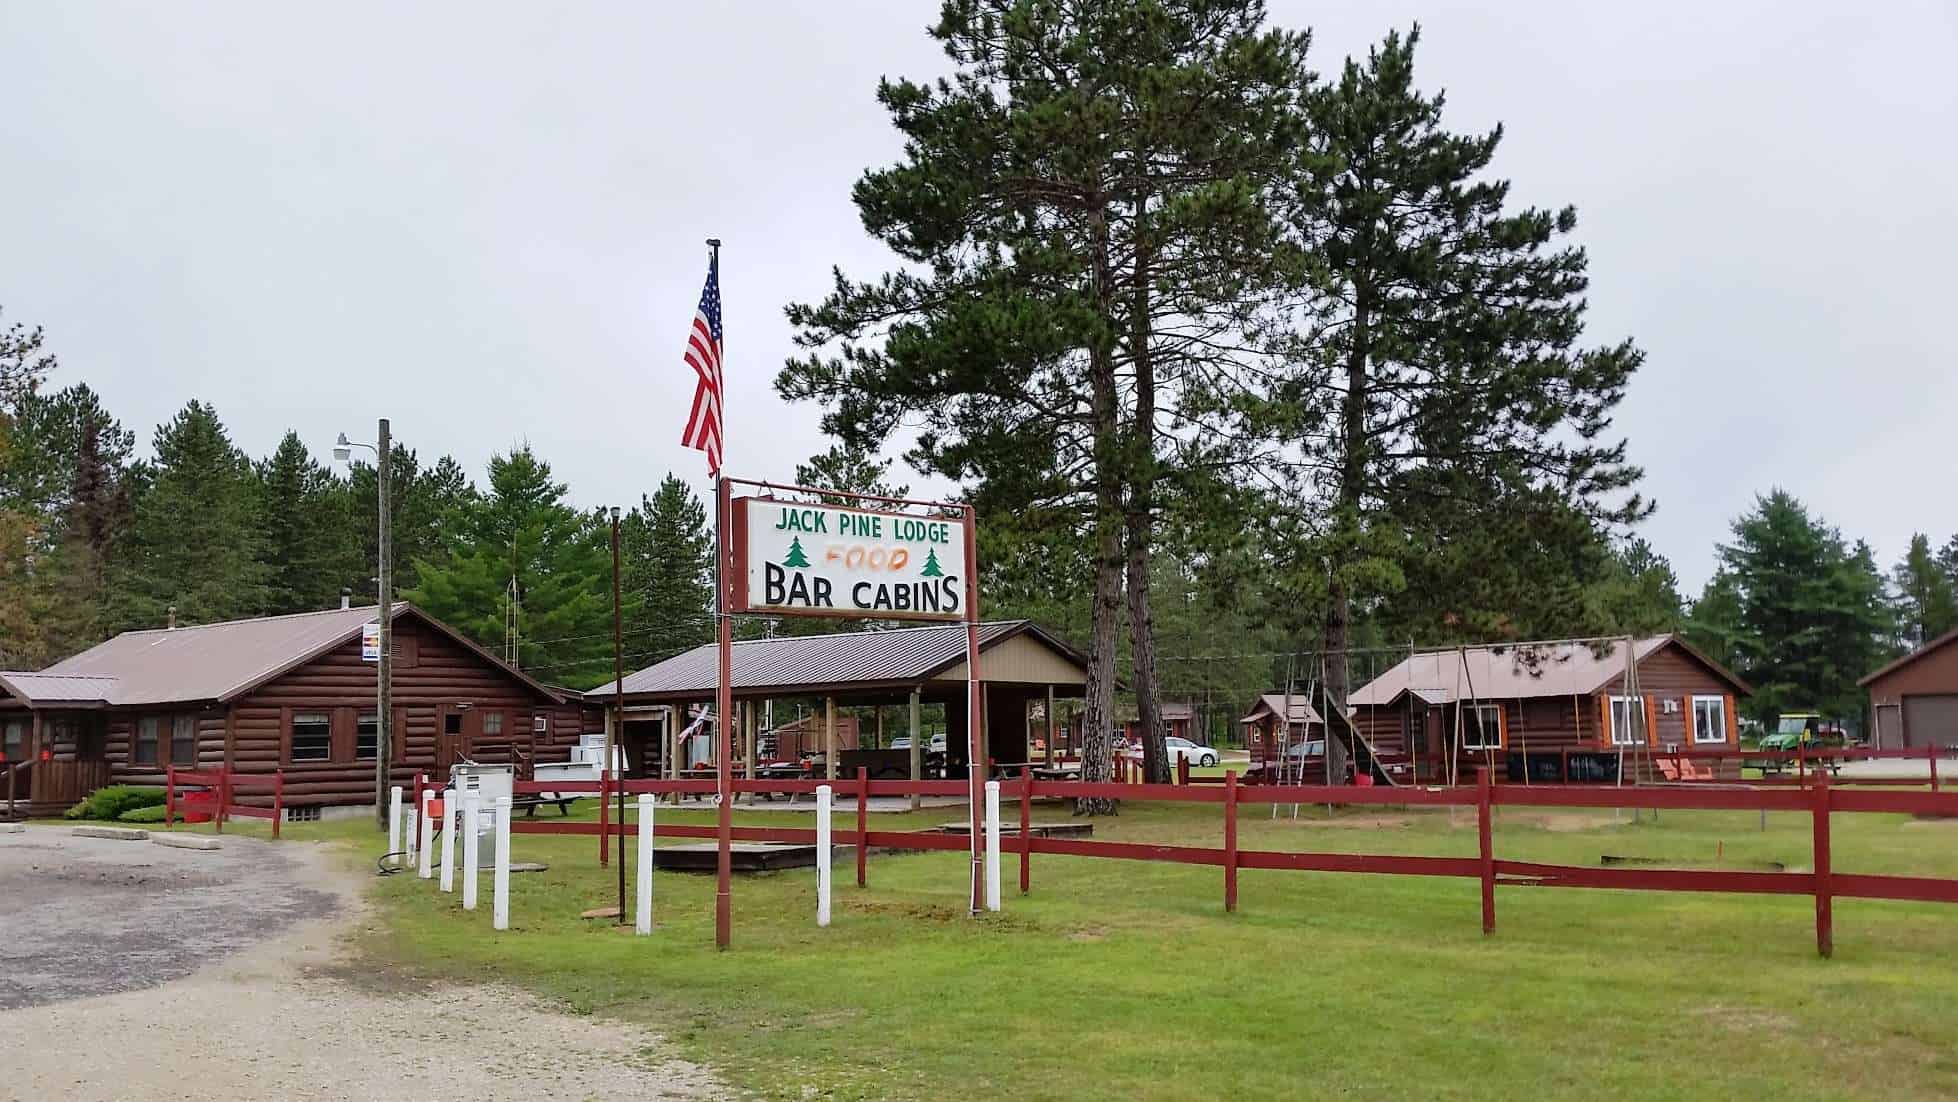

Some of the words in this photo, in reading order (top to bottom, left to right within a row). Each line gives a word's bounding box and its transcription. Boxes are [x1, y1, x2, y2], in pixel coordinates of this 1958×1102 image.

[775, 507, 828, 533] JACK
[839, 513, 882, 538] PINE
[894, 518, 949, 544] LODGE
[824, 545, 909, 571] FOOD
[765, 560, 833, 607] BAR
[852, 575, 959, 613] CABINS
